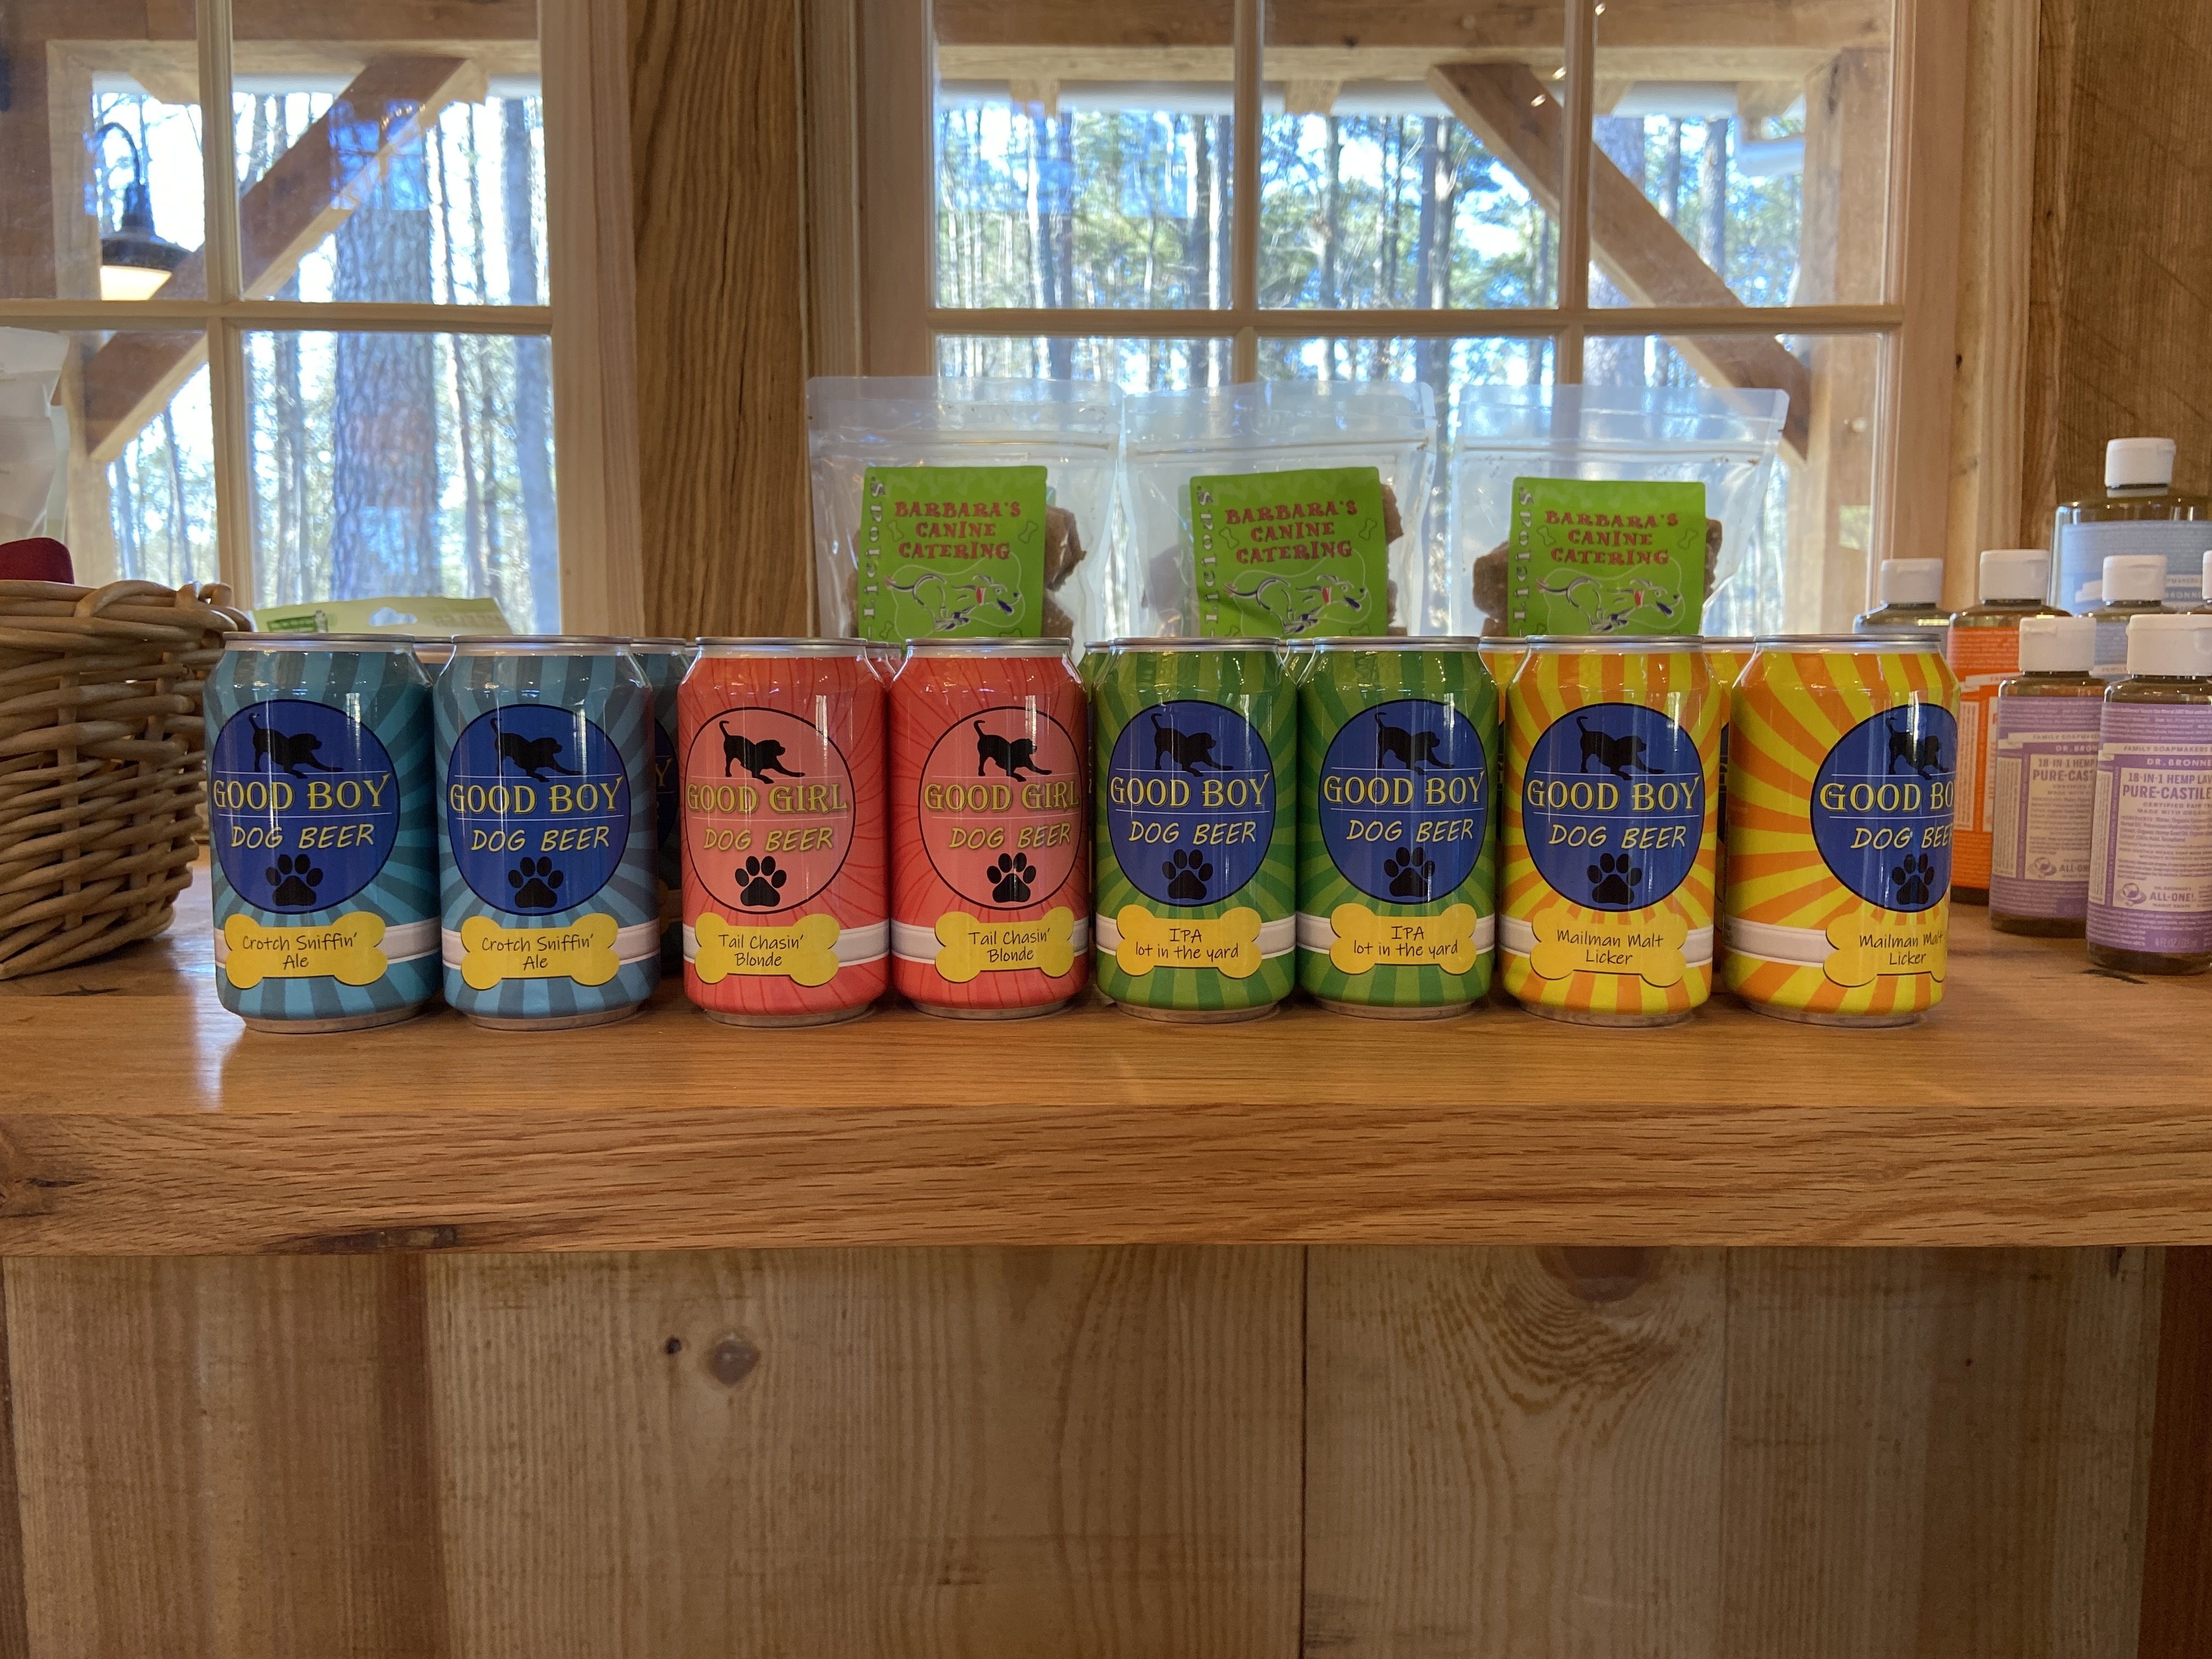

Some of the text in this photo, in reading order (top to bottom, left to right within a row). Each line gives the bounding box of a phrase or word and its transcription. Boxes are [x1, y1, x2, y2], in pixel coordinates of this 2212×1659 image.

[894, 501, 1022, 518] BARBARA'S
[1224, 500, 1358, 525] BARBARA'S
[1545, 510, 1678, 529] BARBARA'S
[915, 521, 997, 539] CANINE
[1250, 521, 1335, 543] CANINE
[1568, 529, 1653, 546] CANINE
[898, 541, 1010, 560] CATERING
[1235, 540, 1352, 565] CATERING
[1550, 548, 1669, 566] CATERING
[1323, 770, 1485, 806] GOOD BOY
[2167, 774, 2195, 785] HEMP
[213, 772, 391, 812] GOOD BOY
[450, 775, 624, 816] GOOD BOY
[687, 782, 850, 814] GOOD GIRL
[925, 780, 1080, 812] GOOD GIRL
[1110, 771, 1270, 808] GOOD BOY
[1527, 776, 1701, 811] GOOD BOY
[1819, 781, 1955, 813] GOOD BO
[2122, 783, 2212, 800] PURE-CASTILE
[231, 823, 375, 850] DOG BEER
[471, 825, 610, 853] DOG BEER
[703, 827, 833, 852] DOG BEER
[949, 822, 1071, 849] DOG BEER
[1128, 820, 1257, 845] DOG BEER
[1346, 819, 1474, 843] DOG BEER
[1549, 823, 1686, 850] DOG BEER
[1850, 827, 1912, 849] DOG
[242, 932, 357, 951] Crotch Sniffin'
[718, 933, 803, 950] Tail Chasin'
[968, 927, 1050, 945] Tail Chasin'
[1169, 927, 1203, 944] IPA
[1391, 924, 1425, 941] IPA
[1556, 929, 1664, 948] Mailman Malt
[1859, 930, 1944, 949] Mailman Malt
[482, 933, 594, 952] Crotch Sniffin'
[1353, 940, 1459, 959] lot in the yard
[283, 953, 309, 969] Ale
[523, 954, 549, 970] Ale
[733, 951, 782, 967] Blonde
[987, 946, 1034, 962] Blonde
[1135, 943, 1239, 962] lot in the yard
[1585, 949, 1633, 966] Licker
[1889, 950, 1927, 966] Licker
